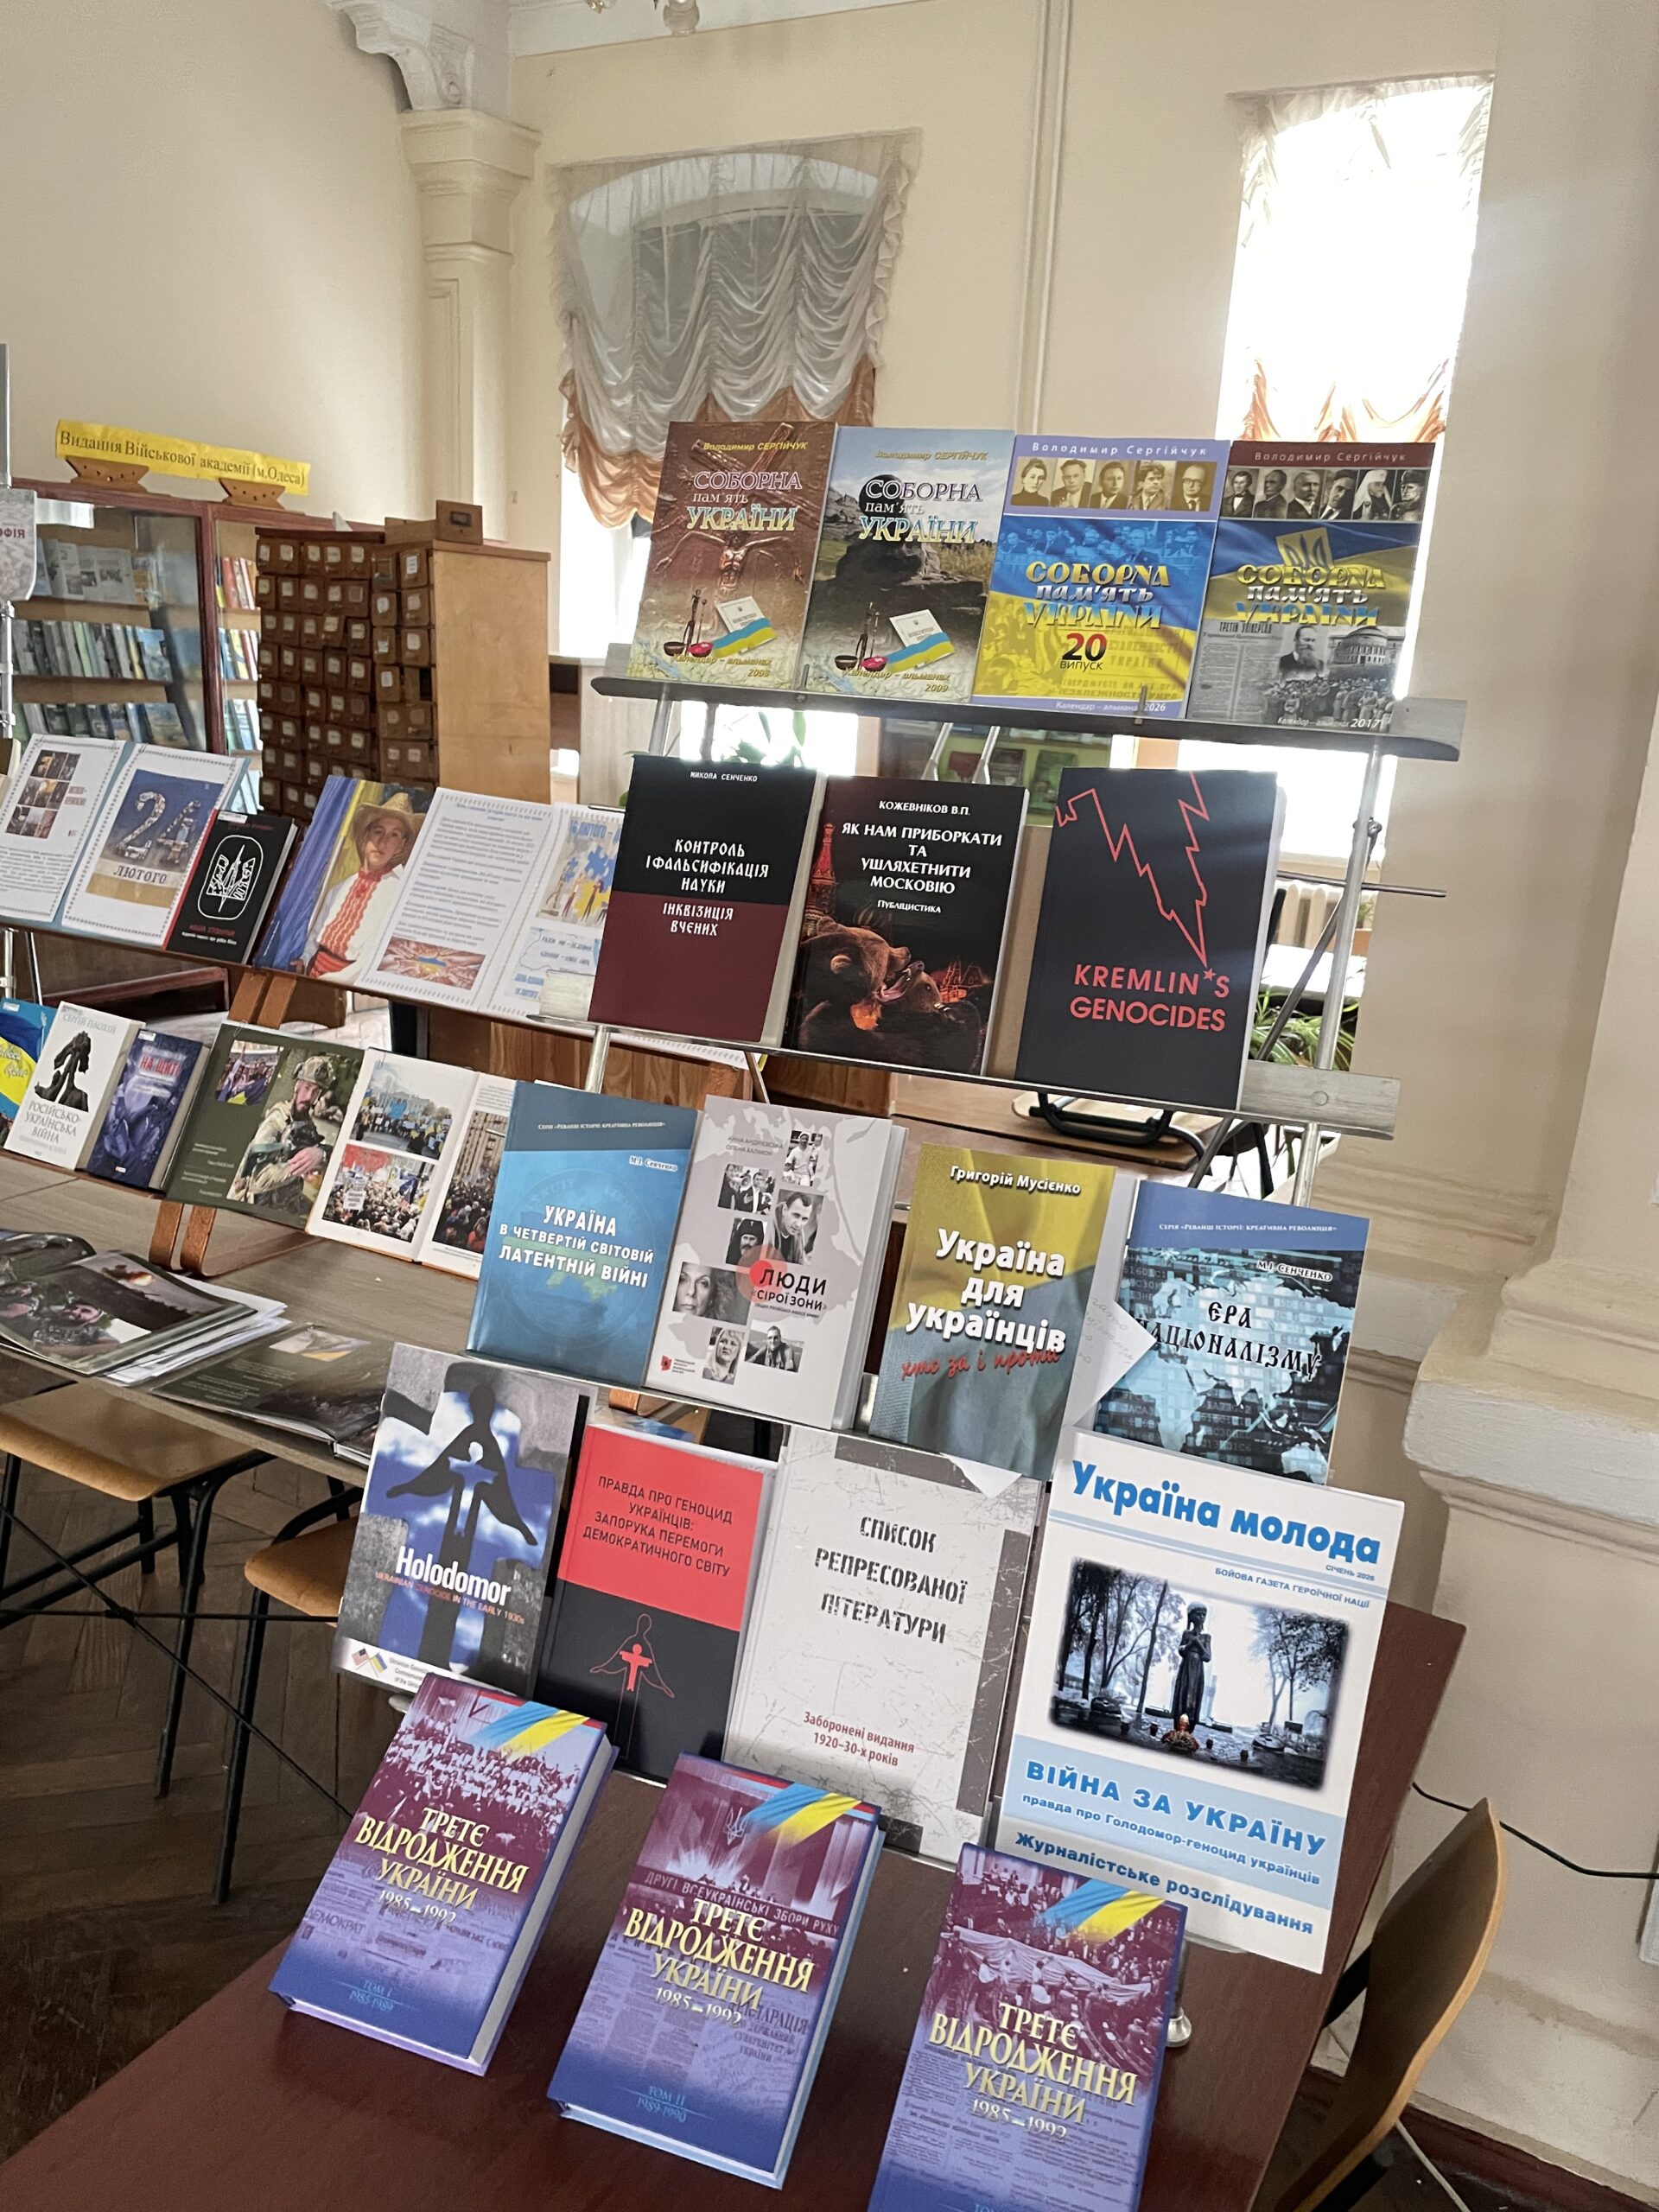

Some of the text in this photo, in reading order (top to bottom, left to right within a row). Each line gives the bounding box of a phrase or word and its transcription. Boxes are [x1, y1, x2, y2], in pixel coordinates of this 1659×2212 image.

[60, 430, 122, 454] Видання
[125, 441, 196, 467] Військової
[200, 459, 251, 475] академії
[703, 441, 808, 452] Володимир СЕРГІЙЧУК
[933, 450, 988, 461] СЕРГІЙЧУК
[1032, 442, 1207, 458] Володимир Сергійчук
[1255, 452, 1406, 463] Володимир Сергійчук
[693, 471, 803, 490] СОБОРНА
[866, 480, 983, 501] СОБОРНА
[686, 503, 798, 531] УКРАЇНИ
[859, 515, 978, 543] УКРАЇНИ
[1026, 562, 1170, 587] СОБОРНА
[1236, 563, 1386, 589] СОБОРНА
[1061, 632, 1107, 661] 20
[925, 683, 949, 692] 2009
[1056, 702, 1095, 712] Календар
[1144, 702, 1166, 712] 2026
[1350, 718, 1380, 728] 2017
[690, 771, 758, 782] МИКОЛА СЕНЧЕНКО
[879, 800, 970, 816] КОЖЕВНІКОВ В.П.
[674, 838, 746, 857] КОНТРОЛЬ
[841, 823, 1002, 847] ЯК НАМ ПРИБОРКАТИ
[908, 844, 927, 858] ТА
[113, 865, 168, 884] ЛЮТОГО
[652, 855, 769, 879] ФАЛЬСИФІКАЦІЯ
[861, 857, 971, 879] УШЛЯХЕТНИТИ
[681, 877, 726, 893] НАУКИ
[870, 875, 956, 894] МОСКОВІЮ
[663, 902, 734, 921] ІНКВІЗИЦІЯ
[1069, 996, 1226, 1032] GENOCIDES
[25, 1112, 76, 1136] УКРАЇНСЬКА
[29, 1101, 81, 1122] РОСІЙСЬКО-
[31, 1128, 59, 1144] ВІЙНА
[950, 1166, 1081, 1194] Григорій Мусієнко
[543, 1205, 617, 1236] УКРАЇНА
[499, 1224, 653, 1263] В ЧЕТВЕРТІЙ СВІТОВІЙ
[936, 1228, 1065, 1277] Україна
[499, 1245, 596, 1277] ЛАТЕНТНІЙ
[601, 1265, 648, 1287] ВІЙНІ
[1276, 1263, 1333, 1282] СЕНЧЕНКО
[760, 1268, 826, 1295] ЛЮДИ
[961, 1276, 1024, 1307] для
[906, 1302, 1066, 1353] українців
[947, 1354, 970, 1378] за
[598, 1476, 733, 1525] ПРАВДА ПРО ГЕНОЦИД
[1072, 1459, 1381, 1565] Україна молода
[628, 1502, 694, 1531] УКРАЇНЦІВ:
[594, 1511, 724, 1557] ЗАПОРУКА ПЕРЕМОГИ
[860, 1516, 937, 1553] СПИСОК
[582, 1526, 730, 1578] ДЕМОКРАТИЧНОГО СВІТУ
[395, 1545, 512, 1606] Holodomor
[815, 1548, 968, 1605] РЕПРЕСОВАНОЇ
[1325, 1564, 1376, 1582] СІЧЕНЬ 2026
[375, 1571, 413, 1589] UKRAINIAN
[415, 1582, 452, 1600] GENOCIDE
[453, 1594, 461, 1604] IN
[462, 1598, 478, 1609] THE
[478, 1604, 502, 1616] EARLY
[1215, 1567, 1370, 1609] БОЙОВА ГАЗЕТА ГЕРОЇЧНОЇ НАЦІЇ
[821, 1592, 947, 1644] ЛІТЕРАТУРИ
[804, 1711, 915, 1753] Заборонені видання
[868, 1750, 899, 1766] років
[1026, 1759, 1326, 1857] ВІЙНА ЗА УКРАЇНУ
[421, 1807, 490, 1848] ТРЕТЄ
[1022, 1793, 1321, 1886] правда про Голодомор-геноцид українців
[353, 1815, 530, 1894] ВІДРОДЖЕННЯ
[375, 1859, 480, 1911] УКРАЇНИ
[1015, 1832, 1313, 1935] Журналістське розслідування
[645, 1872, 840, 1935] ДРУГІ ВСЕУКРАЇНСЬКІ ЗБОРИ РУХУ
[690, 1898, 768, 1942] ТРЕТЄ
[624, 1908, 816, 1993] ВІДРОДЖЕННЯ
[651, 1953, 764, 2011] УКРАЇНИ
[999, 2001, 1080, 2050] ТРЕТЄ
[928, 2012, 1138, 2106] ВІДРОДЖЕННЯ
[963, 2062, 1087, 2125] УКРАЇНИ
